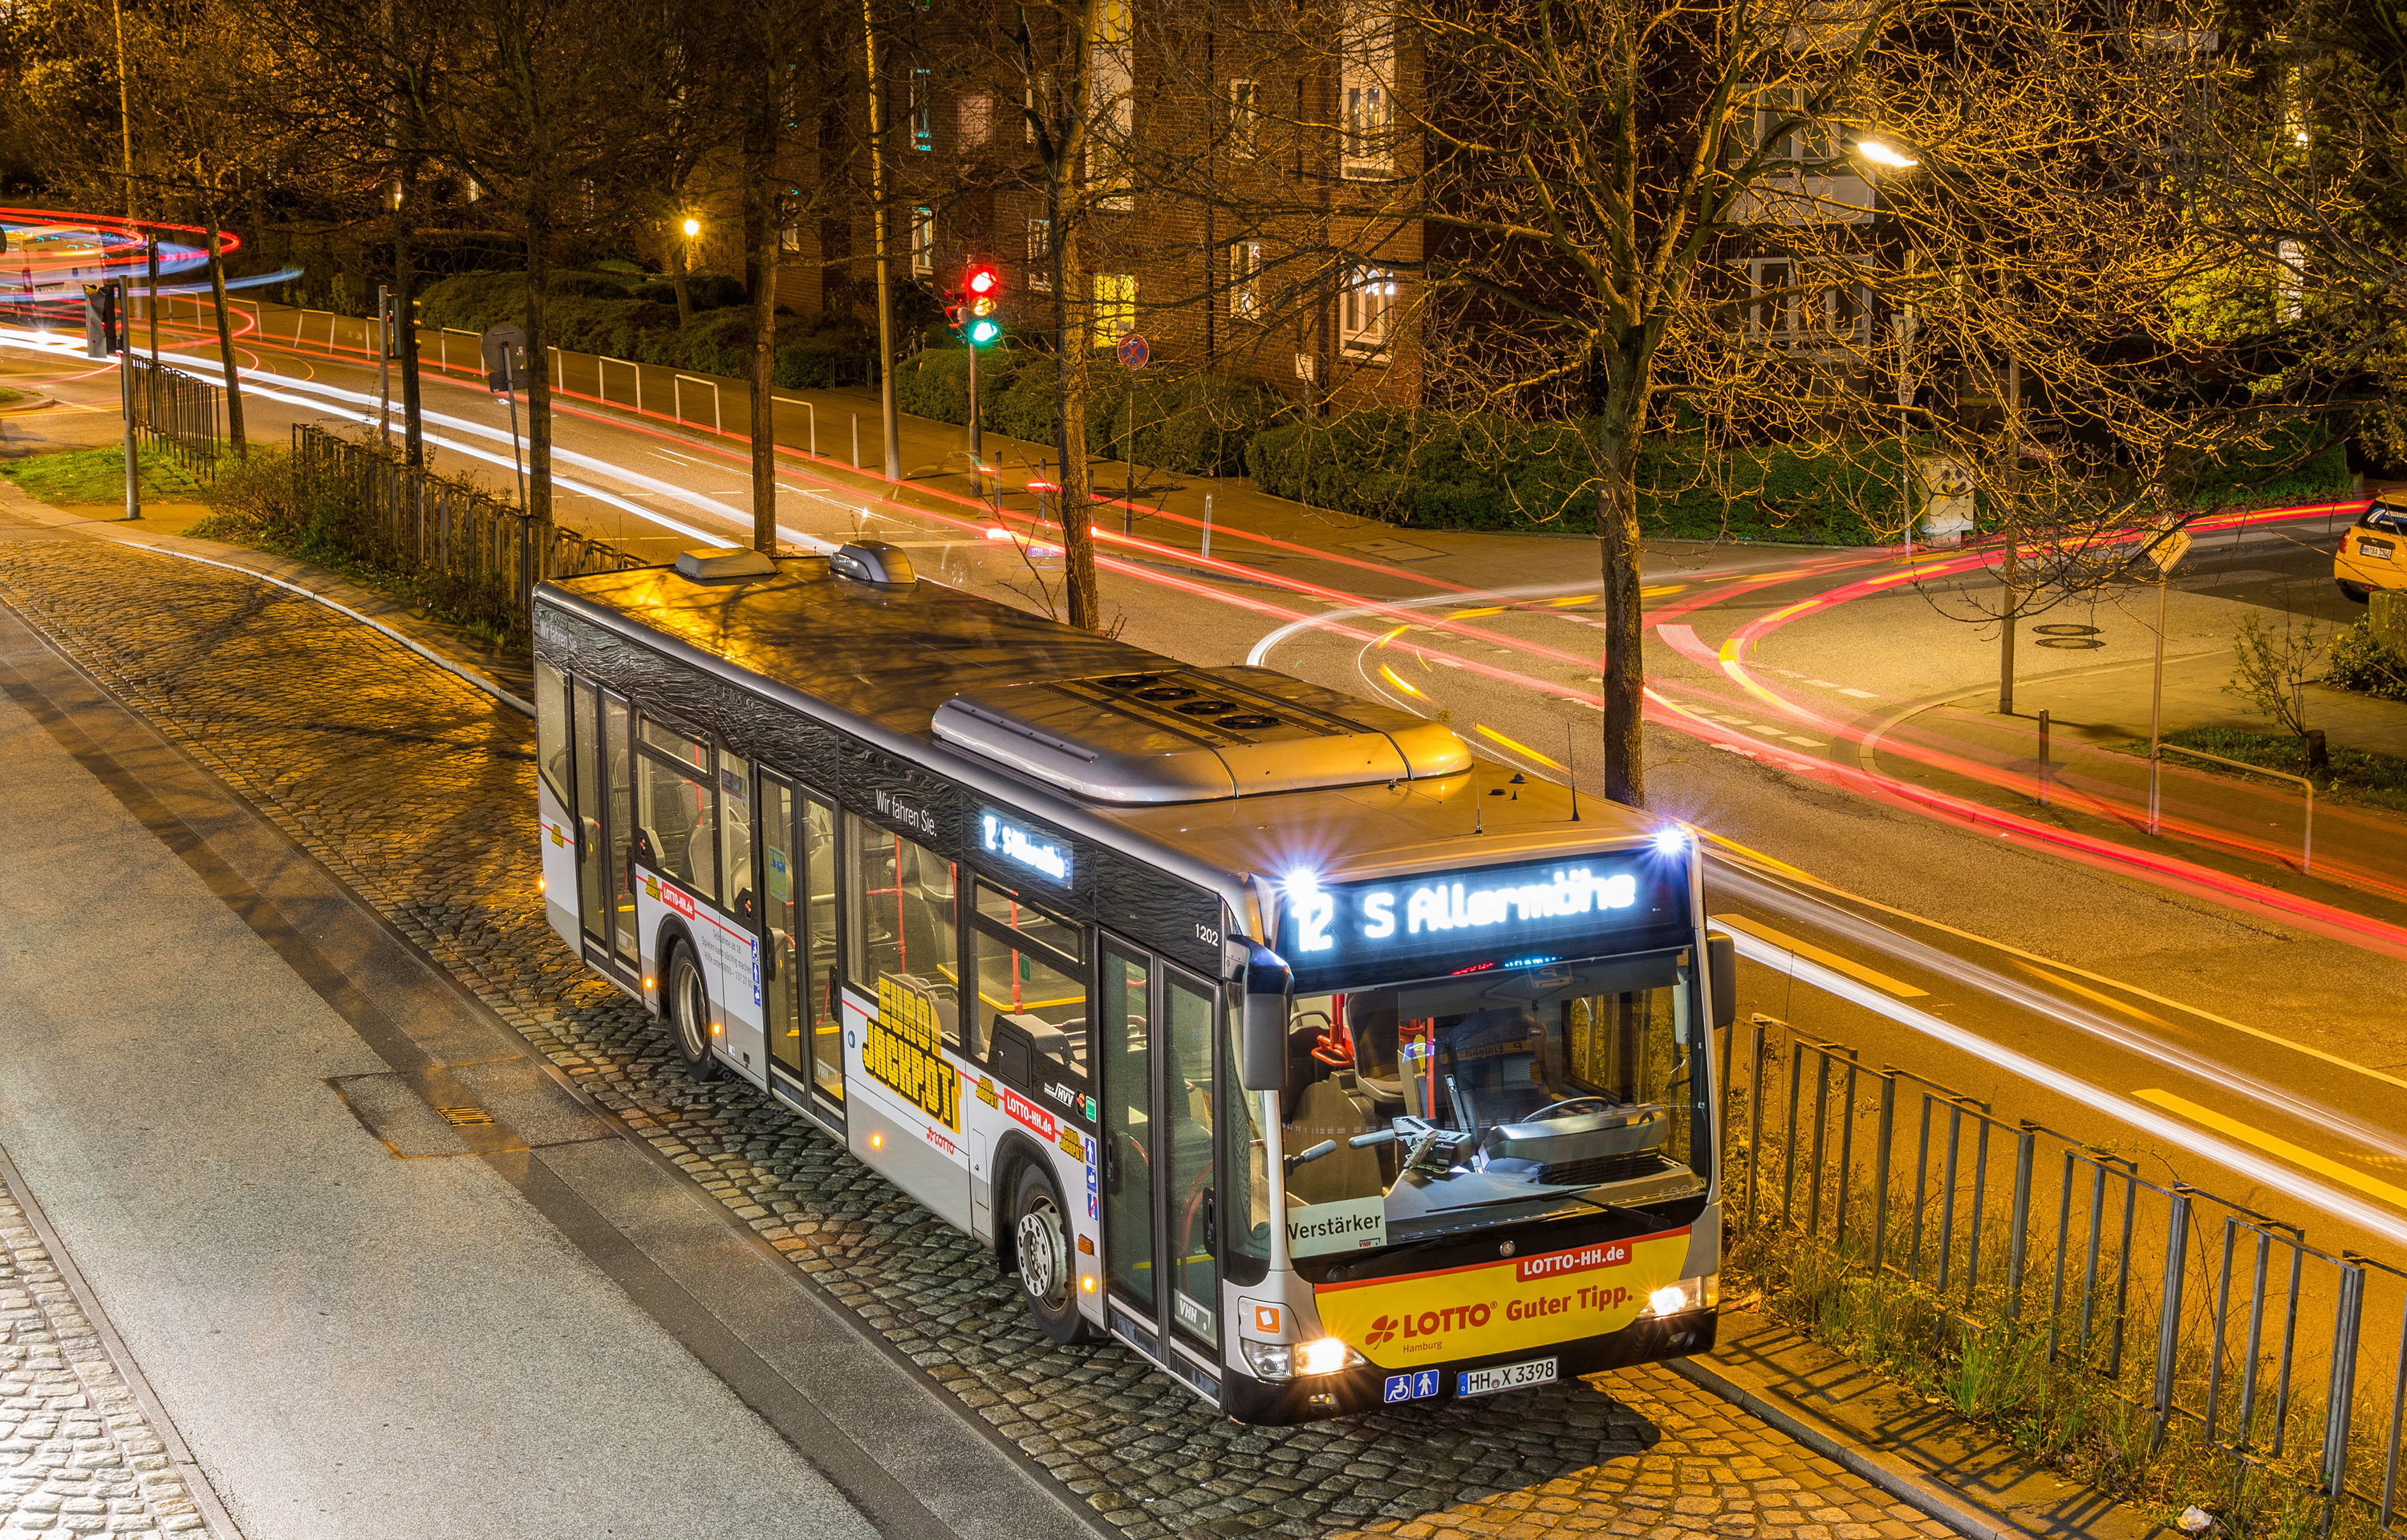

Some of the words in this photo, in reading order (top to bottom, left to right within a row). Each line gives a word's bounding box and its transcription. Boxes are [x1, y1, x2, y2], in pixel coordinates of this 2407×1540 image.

[540, 620, 549, 639] Wir
[550, 625, 567, 650] fahren
[876, 788, 890, 814] Wir
[892, 796, 919, 829] fahren
[921, 809, 936, 837] Sie.
[1291, 891, 1333, 952] 12
[1363, 891, 1394, 938] S
[1408, 869, 1636, 934] Allermöhe
[1195, 923, 1218, 946] 1202
[878, 975, 931, 1051] EURO
[863, 1022, 954, 1121] JACKPOT
[1057, 1087, 1074, 1105] HVV
[1007, 1095, 1052, 1135] LOTTO-HH.de
[935, 1131, 955, 1156] LOTTO
[1659, 1182, 1701, 1202] 1202
[1288, 1213, 1381, 1241] Verstärker
[1524, 1246, 1625, 1275] LOTTO-HH.de
[1179, 1299, 1197, 1324] VHH
[1506, 1294, 1571, 1321] Guter
[1577, 1285, 1634, 1311] Tipp.
[1402, 1340, 1443, 1353] Hamburg
[1469, 1372, 1491, 1392] HH
[1502, 1368, 1512, 1386] X
[1515, 1360, 1554, 1383] 3398
